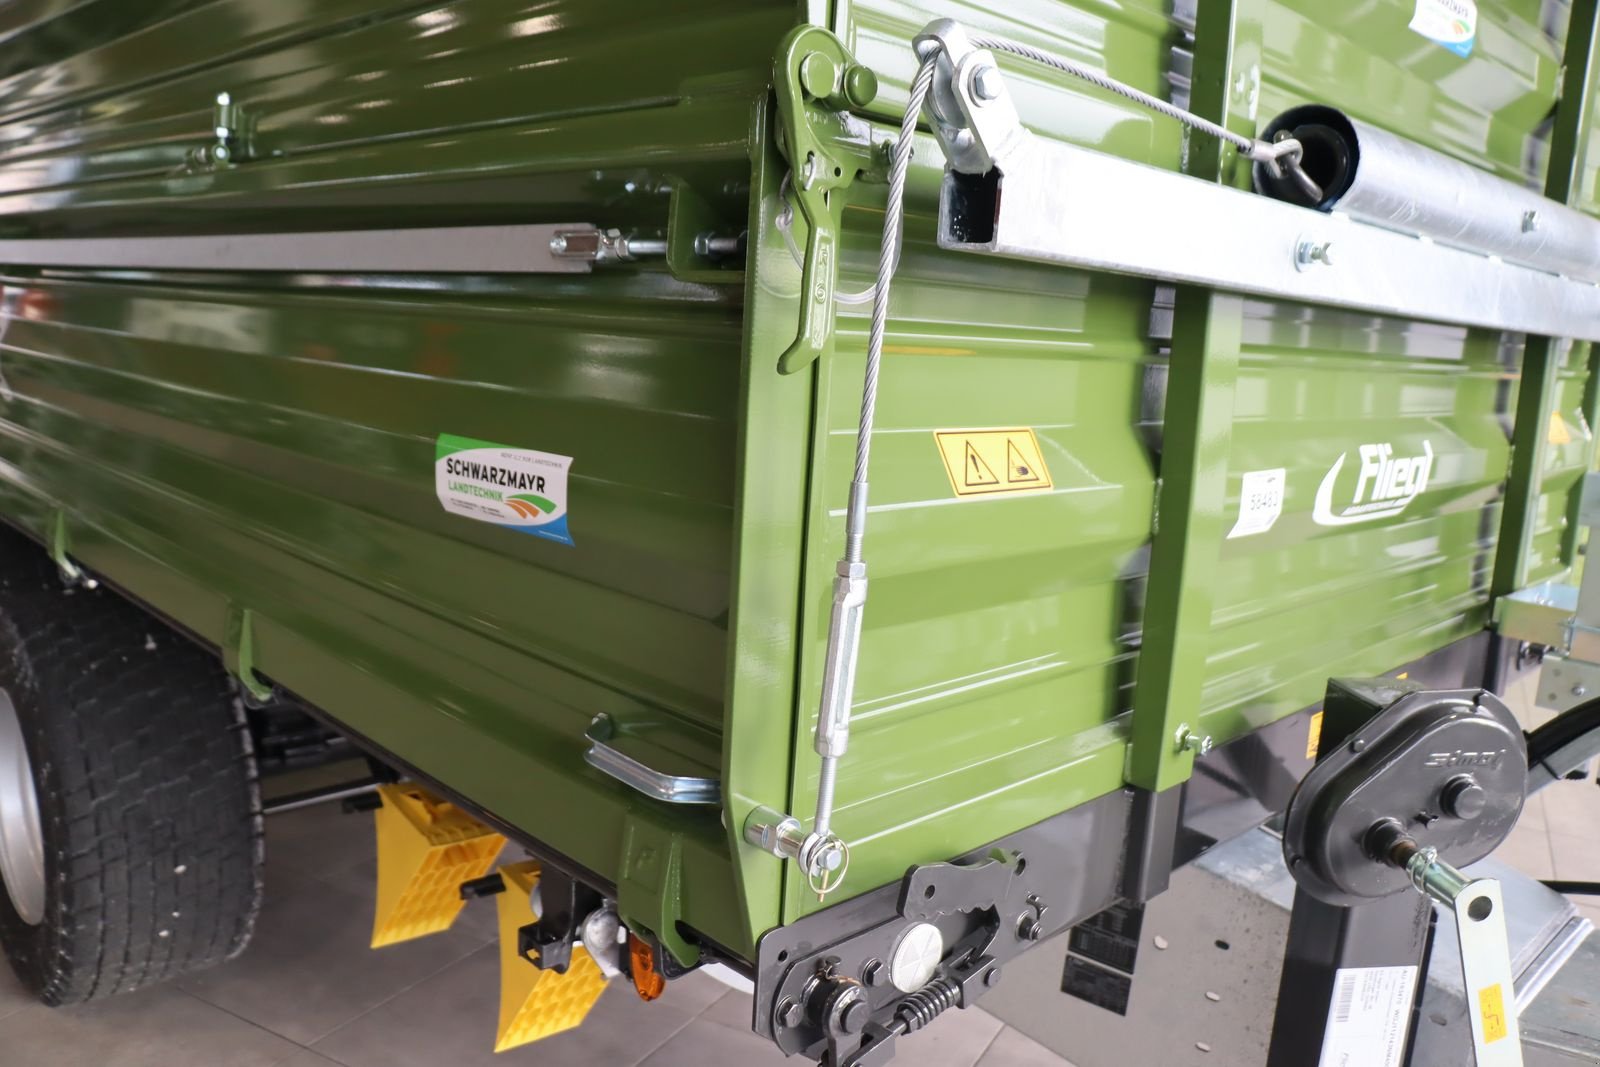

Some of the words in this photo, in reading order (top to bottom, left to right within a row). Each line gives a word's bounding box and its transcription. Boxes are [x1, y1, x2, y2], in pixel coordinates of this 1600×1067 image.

[446, 457, 546, 494] SCHWARZMAYR
[1352, 440, 1433, 504] Fliegl
[448, 480, 503, 502] LANDTECHNIK
